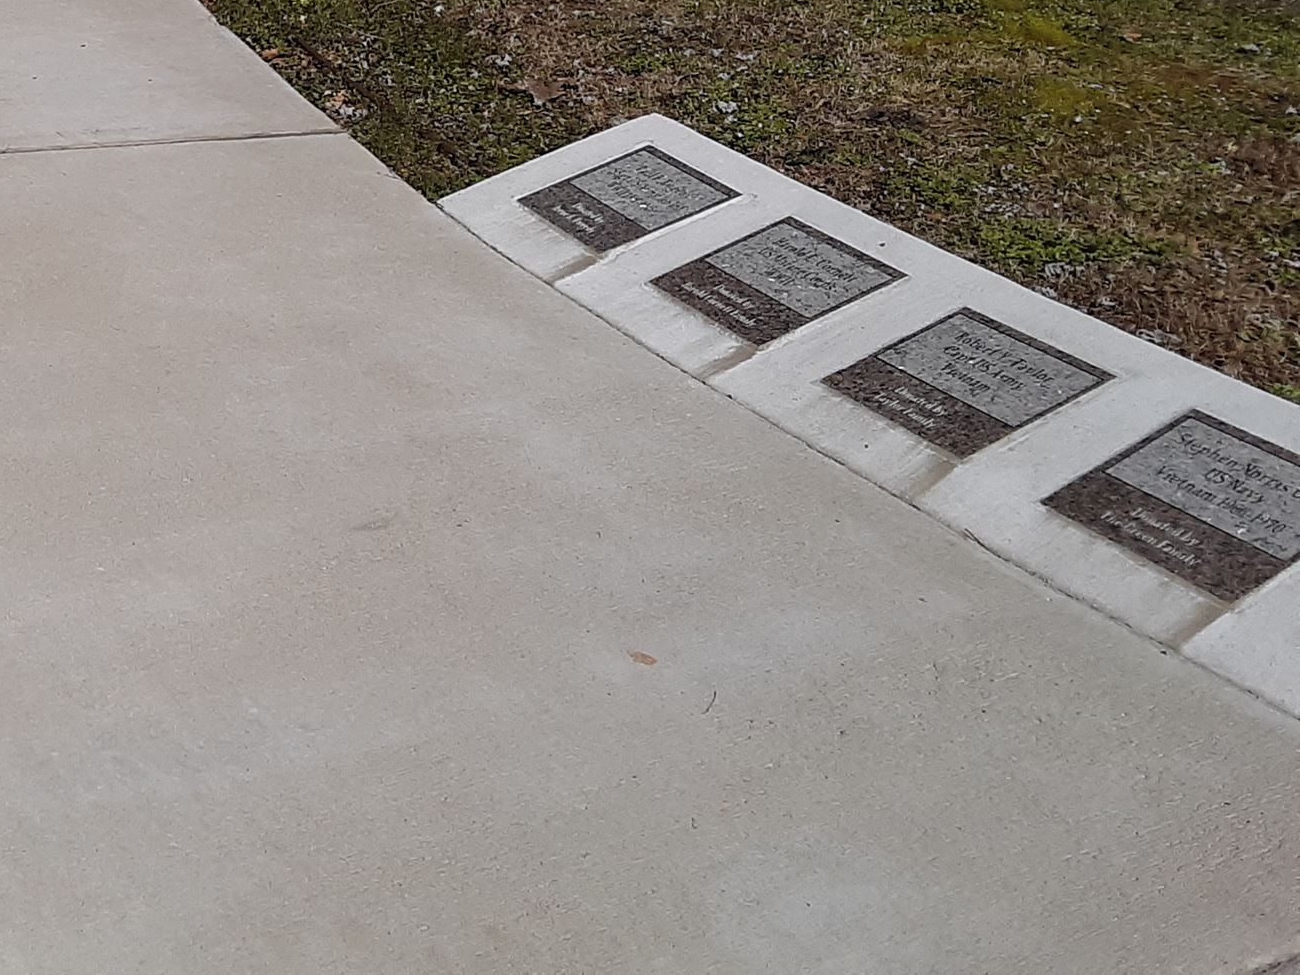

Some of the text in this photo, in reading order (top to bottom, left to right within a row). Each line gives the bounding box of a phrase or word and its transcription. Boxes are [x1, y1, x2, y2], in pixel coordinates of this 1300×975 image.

[952, 332, 1002, 356] Robert
[1008, 358, 1059, 383] Taylor
[1169, 432, 1243, 470] Stephen
[1151, 465, 1222, 503] Vietnam
